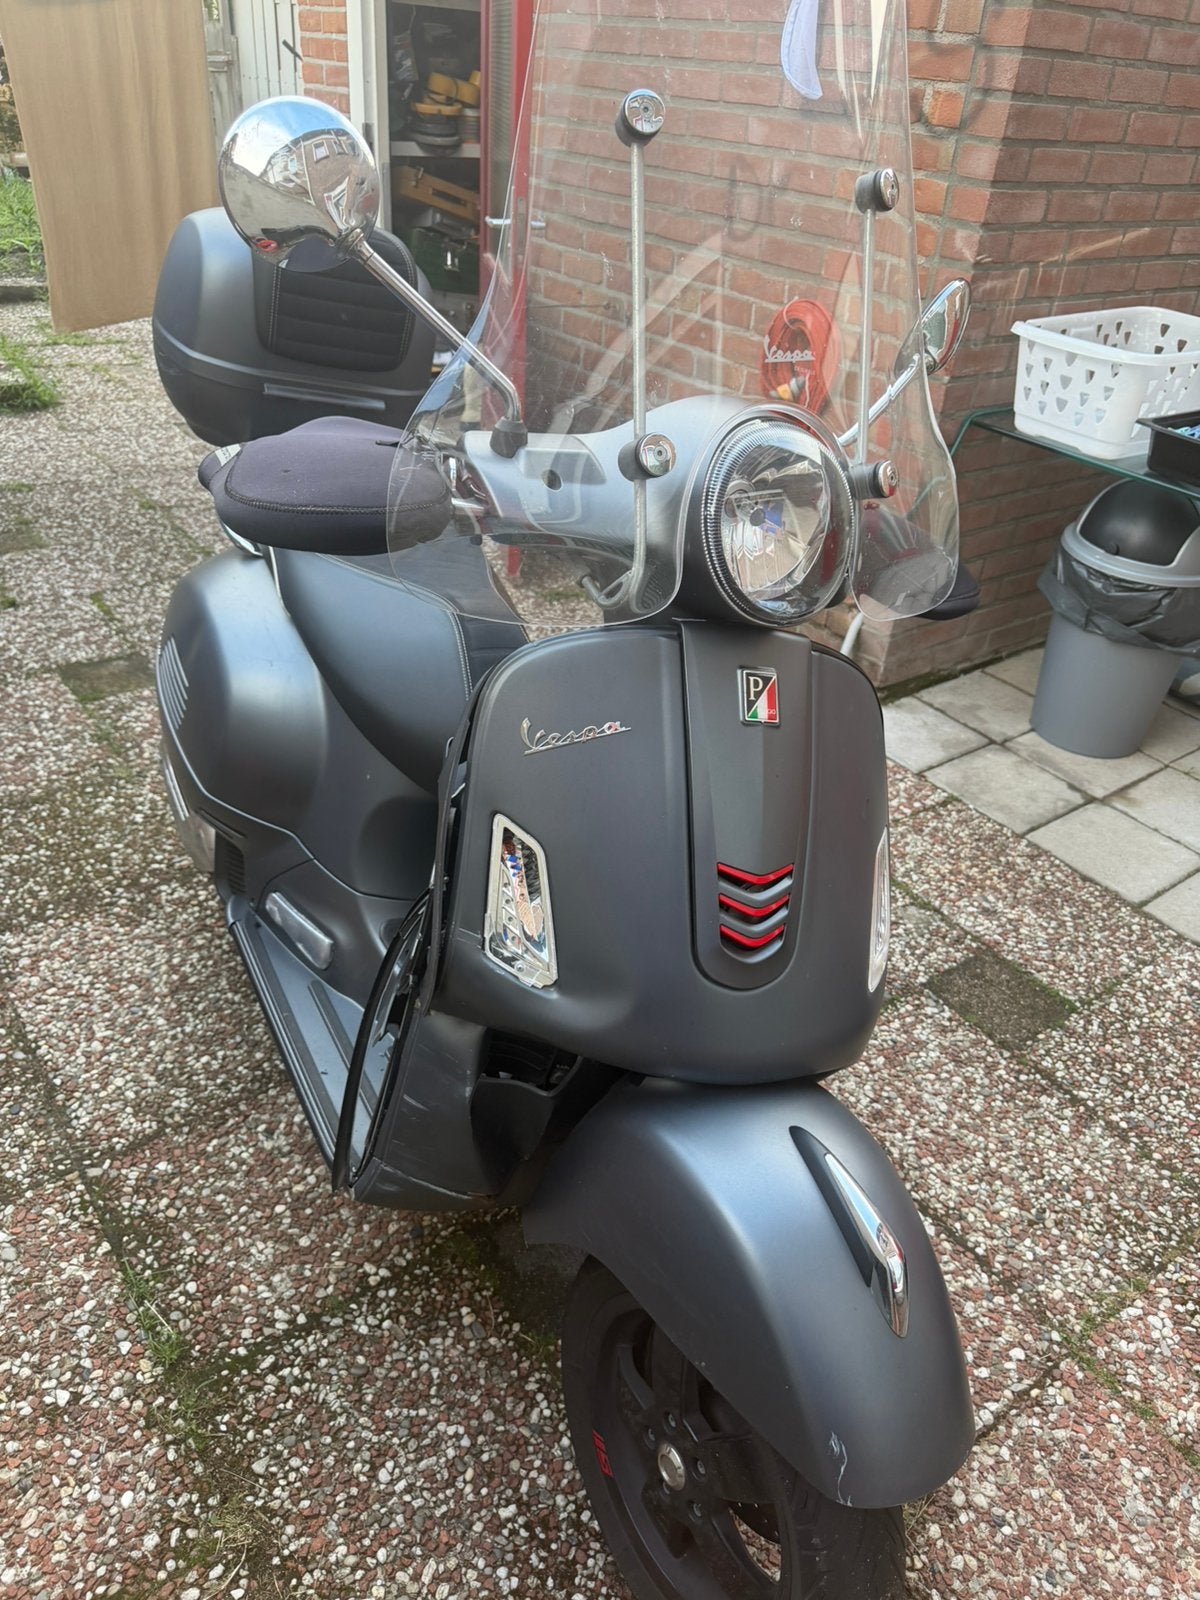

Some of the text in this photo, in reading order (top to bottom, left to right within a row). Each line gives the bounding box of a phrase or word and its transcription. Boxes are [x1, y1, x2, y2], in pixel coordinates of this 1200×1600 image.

[764, 335, 816, 363] Vespa
[748, 676, 764, 701] P
[521, 717, 631, 755] Vespa
